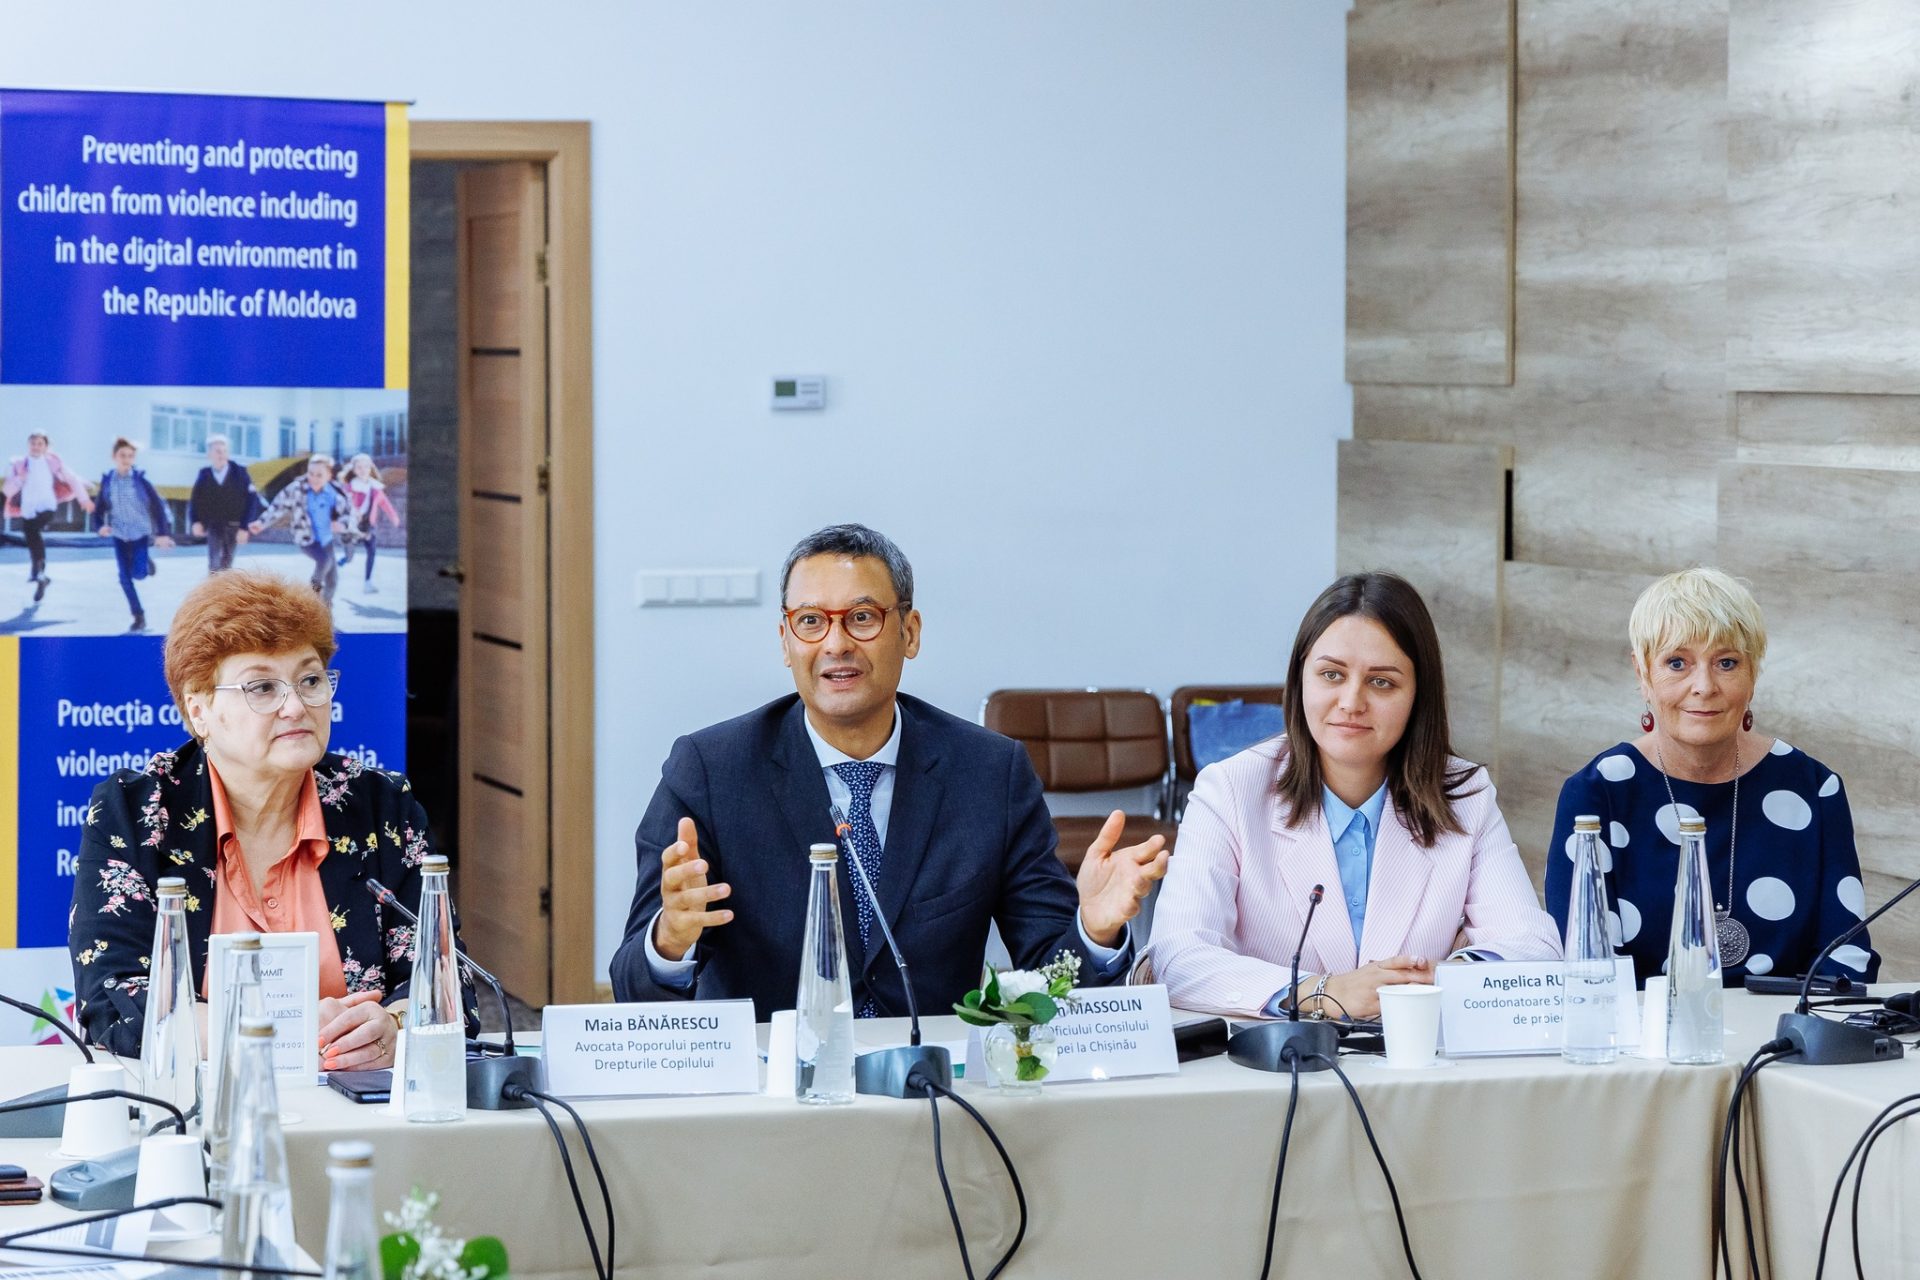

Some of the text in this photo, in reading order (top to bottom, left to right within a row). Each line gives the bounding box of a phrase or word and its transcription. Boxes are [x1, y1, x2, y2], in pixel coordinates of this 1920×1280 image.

[82, 134, 358, 178] Preventing and protecting
[17, 183, 357, 228] children from violence including
[55, 235, 358, 273] in the digital environment in
[103, 286, 357, 322] the Republic of Moldova
[57, 799, 91, 827] inc
[57, 849, 79, 877] Re
[1483, 975, 1563, 991] Angelica RU
[1069, 999, 1142, 1016] MASSOLIN
[1463, 996, 1550, 1010] Coordonatoare
[585, 1015, 719, 1032] Maia BĂNĂRESCU
[1095, 1021, 1150, 1035] Consilului
[1513, 1013, 1563, 1028] de proie
[575, 1039, 731, 1053] Avocata Poporului pentru
[1057, 1040, 1137, 1057] pei la Chișinău
[594, 1057, 714, 1072] Drepturile Copilului
